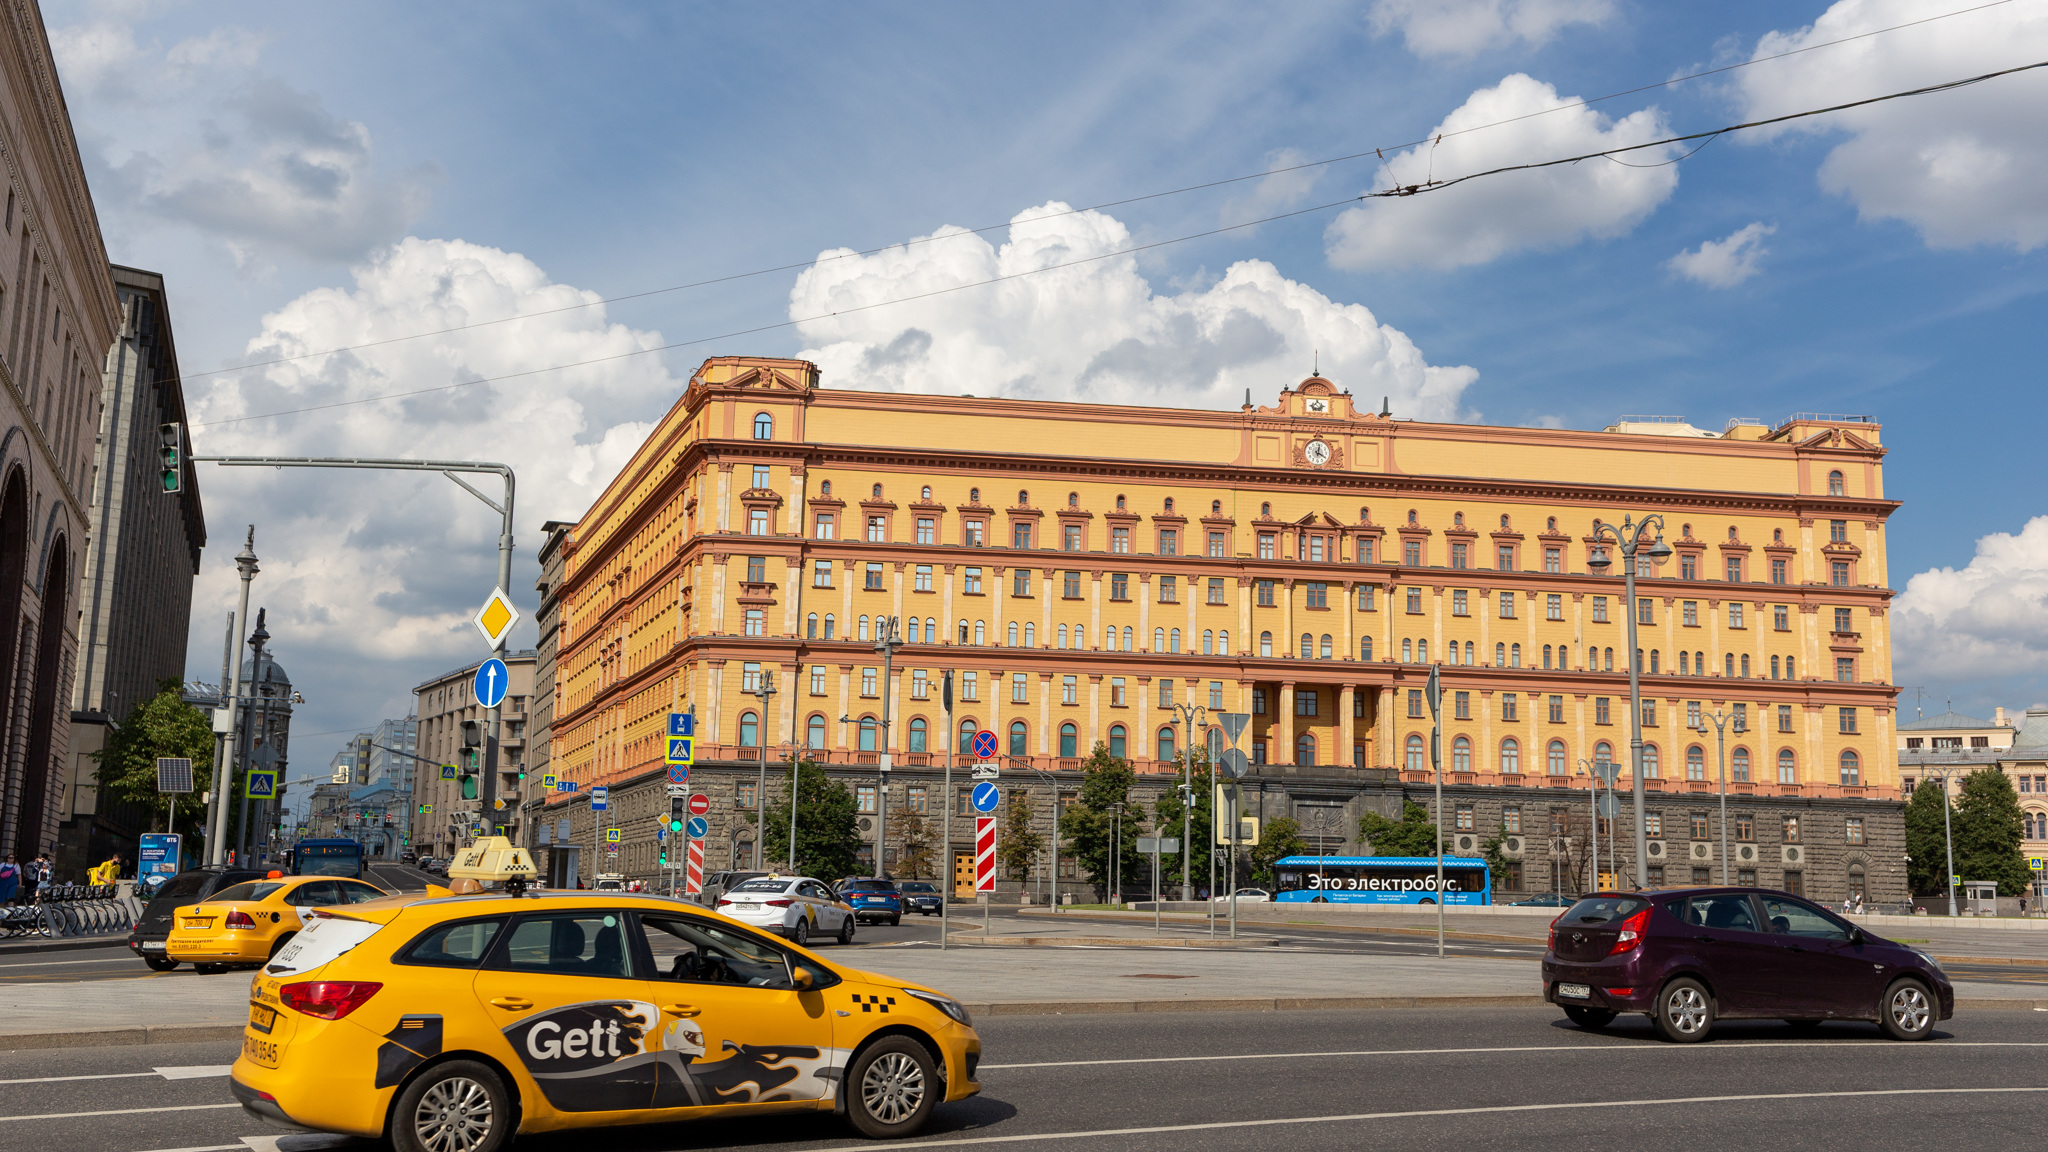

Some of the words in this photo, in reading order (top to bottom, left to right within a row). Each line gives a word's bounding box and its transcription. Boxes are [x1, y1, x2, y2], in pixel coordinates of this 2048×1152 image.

[464, 852, 478, 867] Gett
[1307, 873, 1342, 890] Это
[526, 1019, 622, 1060] Gett
[259, 1040, 278, 1063] 3545
